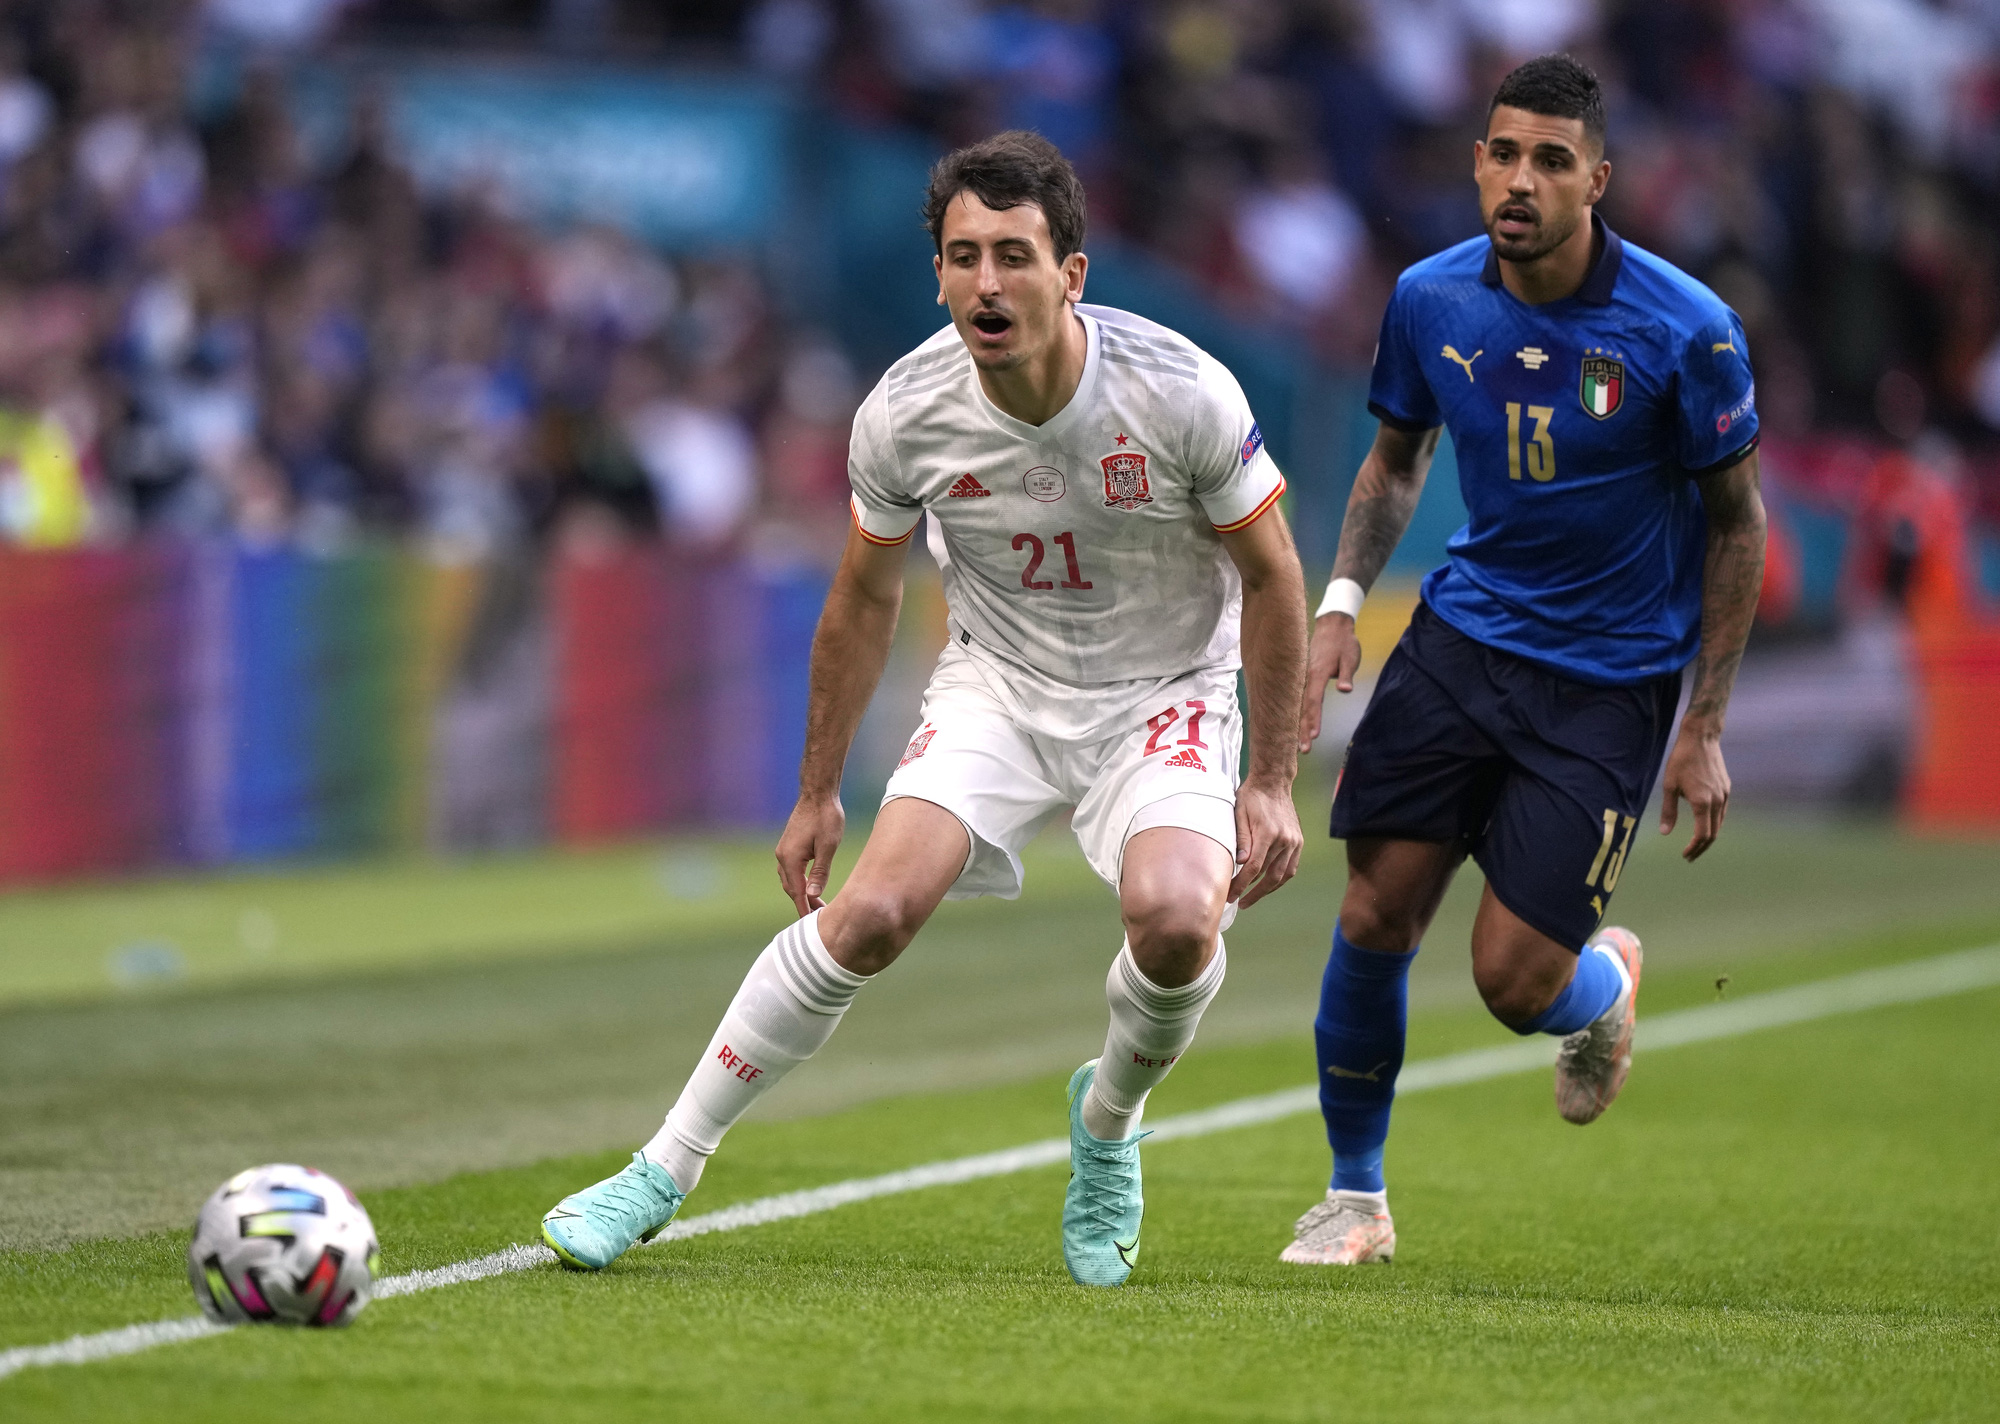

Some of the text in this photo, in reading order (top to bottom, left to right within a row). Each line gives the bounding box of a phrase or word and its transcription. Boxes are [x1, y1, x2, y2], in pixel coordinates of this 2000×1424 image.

[1585, 361, 1621, 374] ITALIA
[1506, 402, 1556, 482] 13
[949, 488, 991, 498] adidas
[1011, 531, 1094, 590] 21
[1143, 700, 1209, 758] 21
[1164, 760, 1207, 773] adidas
[1585, 808, 1637, 893] 13
[717, 1044, 764, 1083] RFEF
